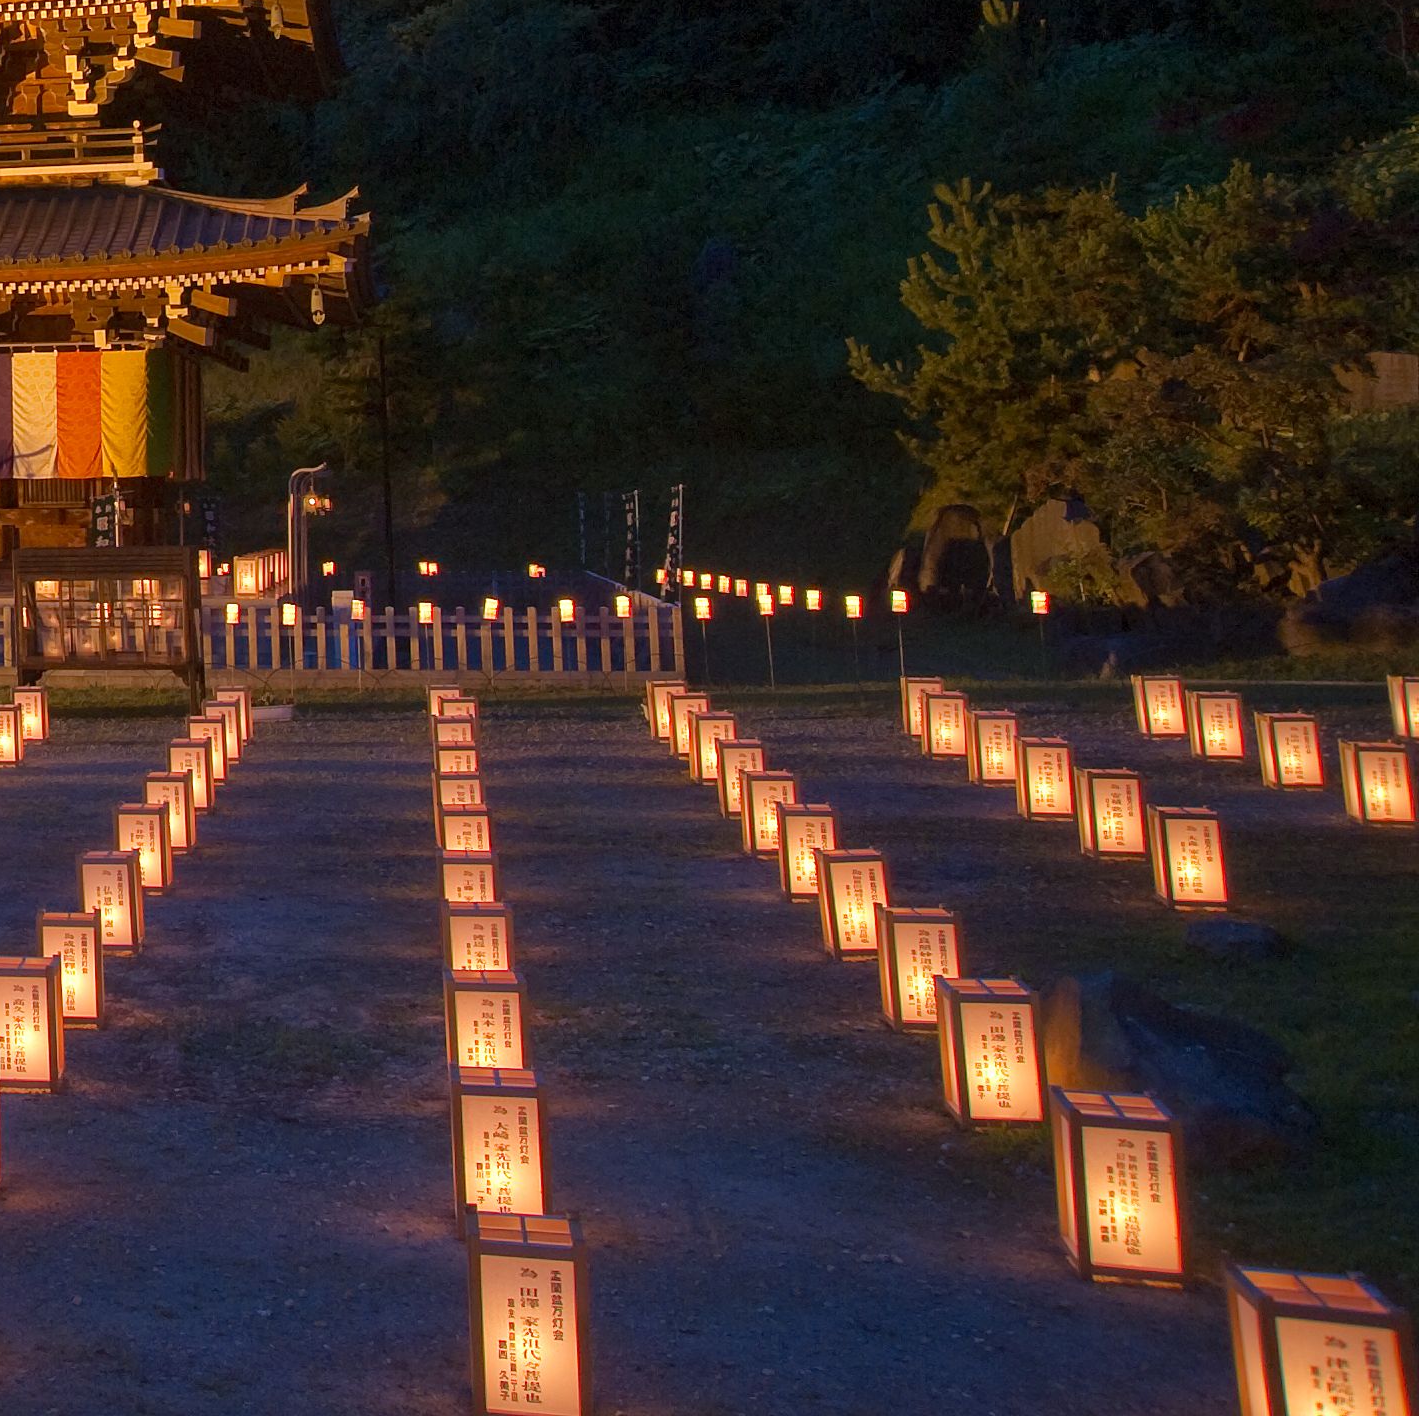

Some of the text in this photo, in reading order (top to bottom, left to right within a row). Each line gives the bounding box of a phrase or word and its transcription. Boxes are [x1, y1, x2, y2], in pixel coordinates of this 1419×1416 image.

[517, 1105, 529, 1164] 盂蘭盆万灯会
[550, 1270, 564, 1341] 盂蘭盆万灯会
